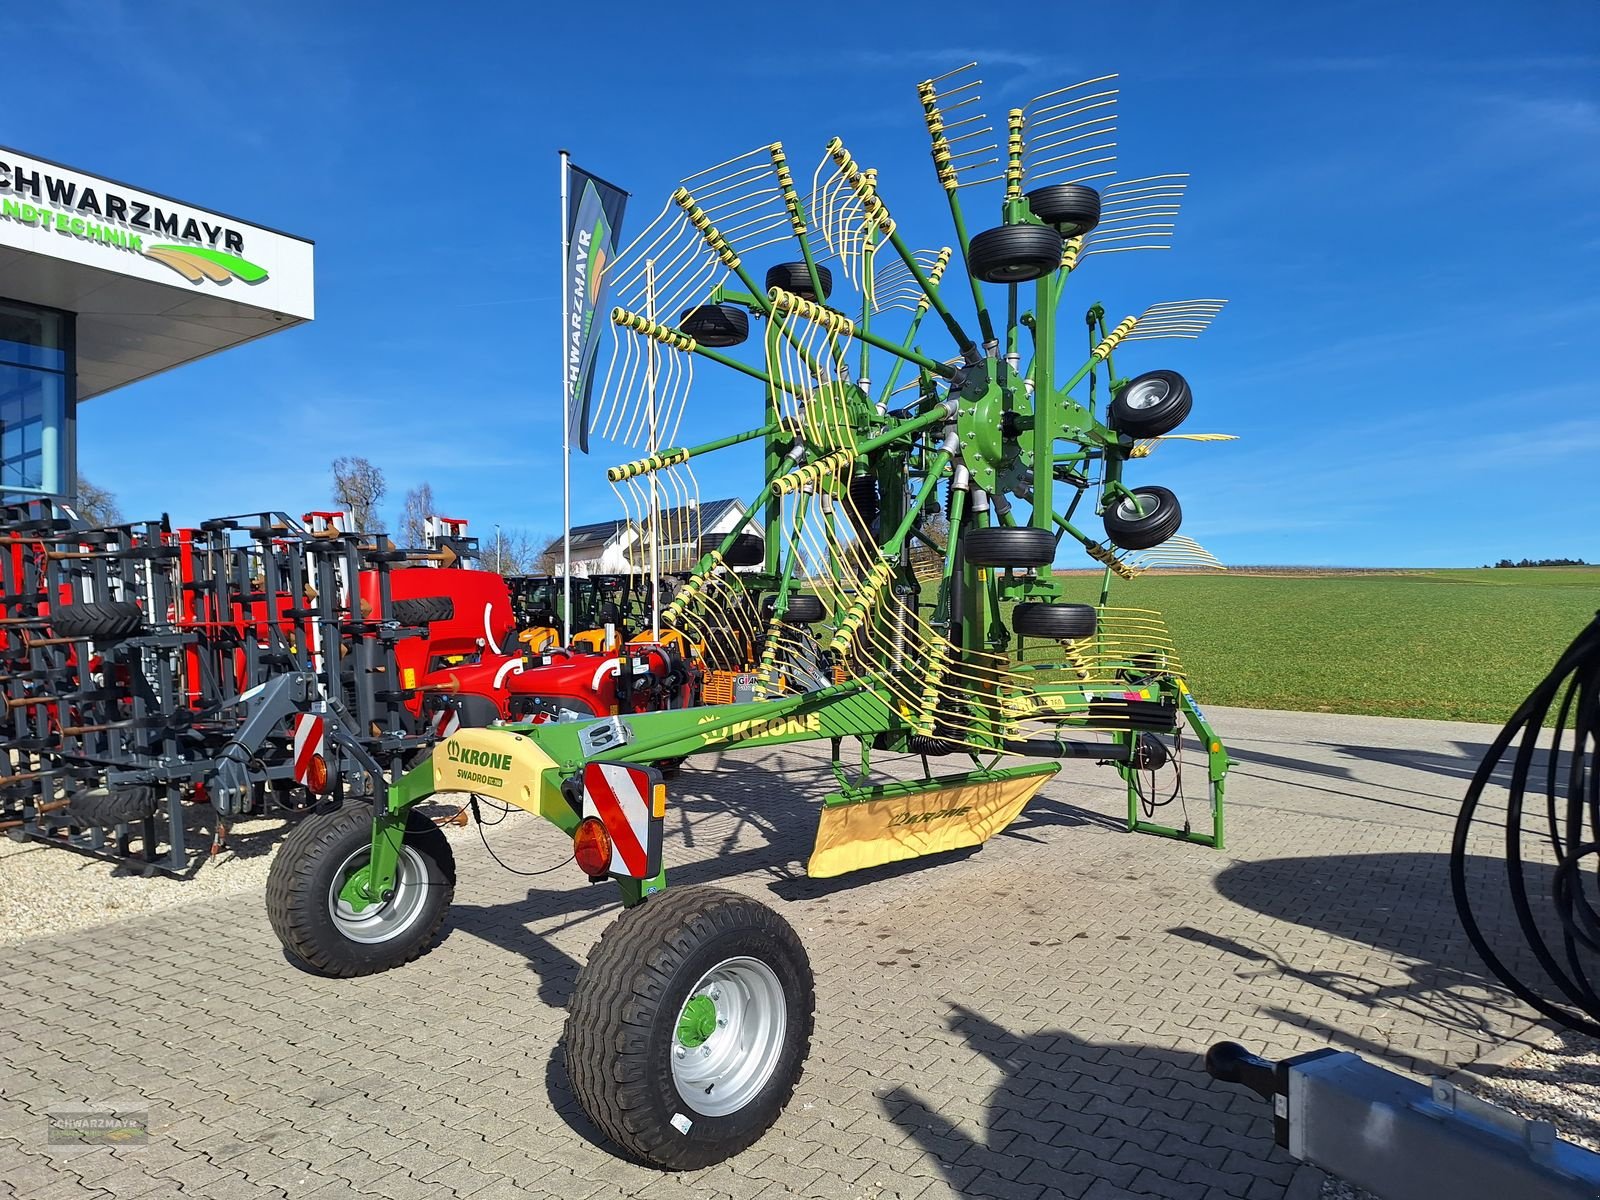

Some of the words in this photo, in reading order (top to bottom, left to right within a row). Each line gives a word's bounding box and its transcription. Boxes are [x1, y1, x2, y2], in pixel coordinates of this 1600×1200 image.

[738, 675, 759, 685] GIAN
[732, 712, 821, 741] KRONE
[460, 748, 512, 770] KRONE
[457, 769, 487, 784] SWADRO
